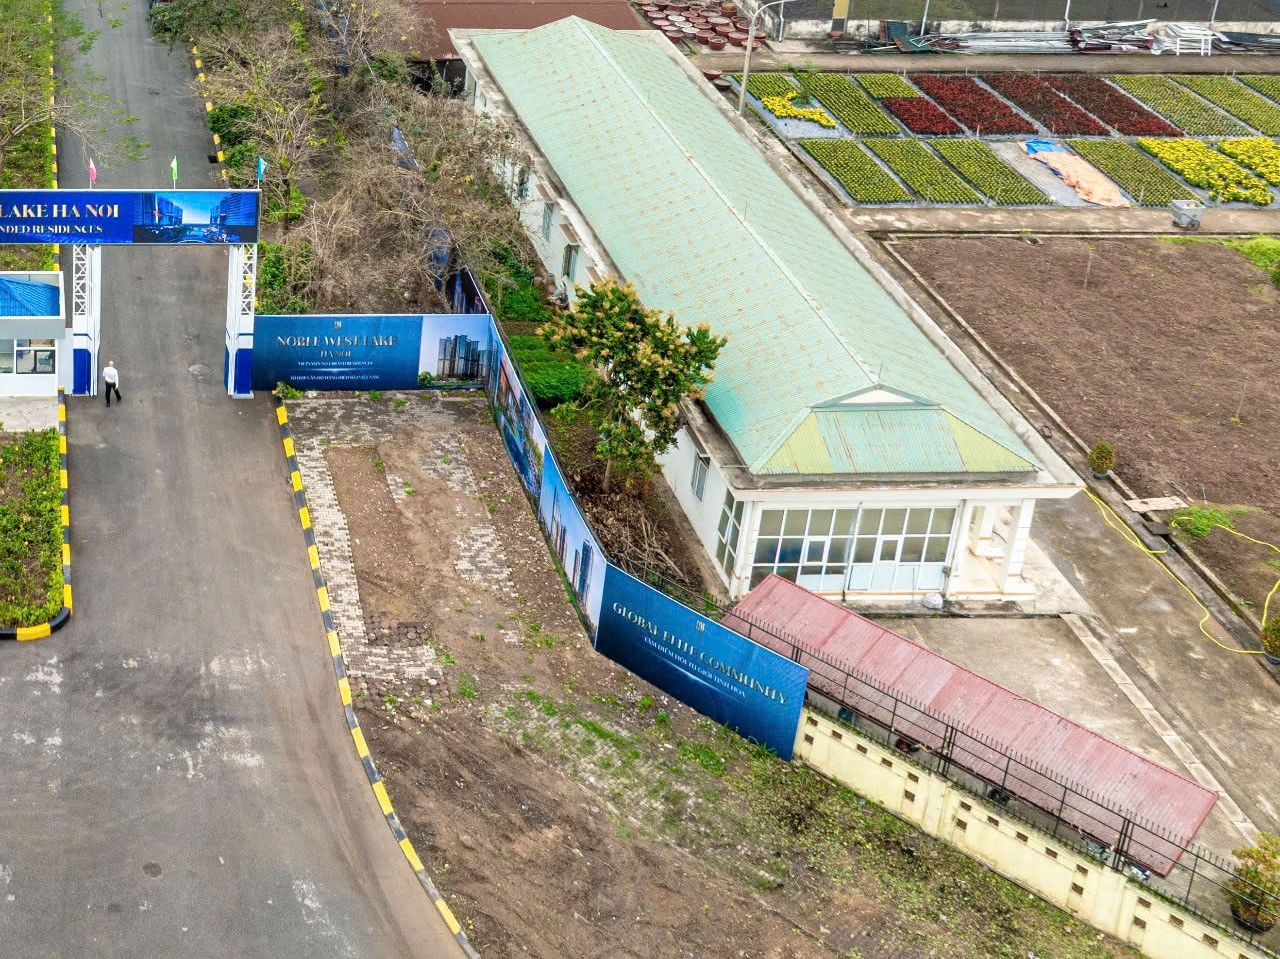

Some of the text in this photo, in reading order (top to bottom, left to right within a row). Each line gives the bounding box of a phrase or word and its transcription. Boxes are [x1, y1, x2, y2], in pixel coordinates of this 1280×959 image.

[52, 204, 81, 218] HA
[85, 204, 119, 218] NOI
[32, 225, 103, 234] RESIDENCES
[276, 335, 397, 347] NOBLE WEST LAKE
[613, 602, 789, 705] GLOBAL ELITE COMMUNITY
